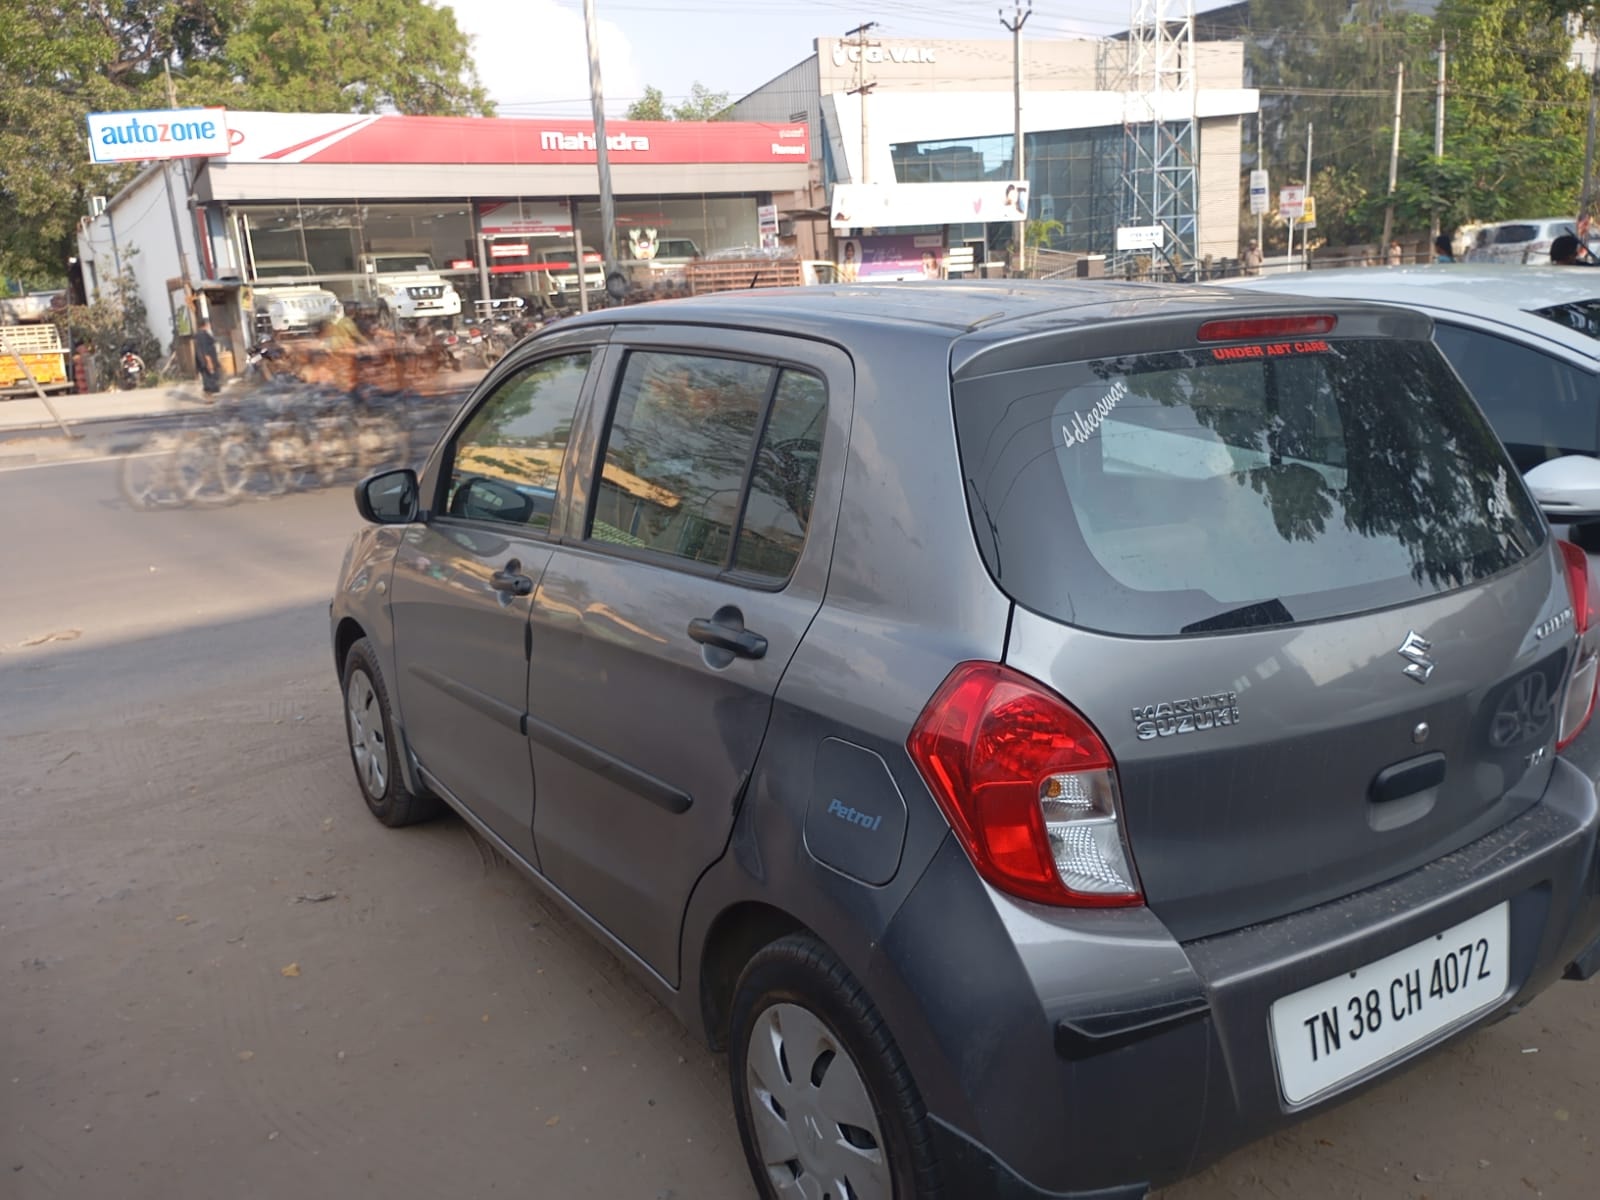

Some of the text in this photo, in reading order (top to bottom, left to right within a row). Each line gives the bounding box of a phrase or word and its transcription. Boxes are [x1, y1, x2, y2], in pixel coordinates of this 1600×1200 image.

[101, 118, 216, 145] autozone
[1212, 340, 1329, 360] UNDER ABT CARE
[1062, 381, 1128, 448] Adheeswar
[1131, 690, 1237, 721] MARUTI
[1136, 706, 1240, 741] SUZUKI
[827, 798, 882, 831] Petrol
[1303, 938, 1491, 1062] TN 38 CH 4072
